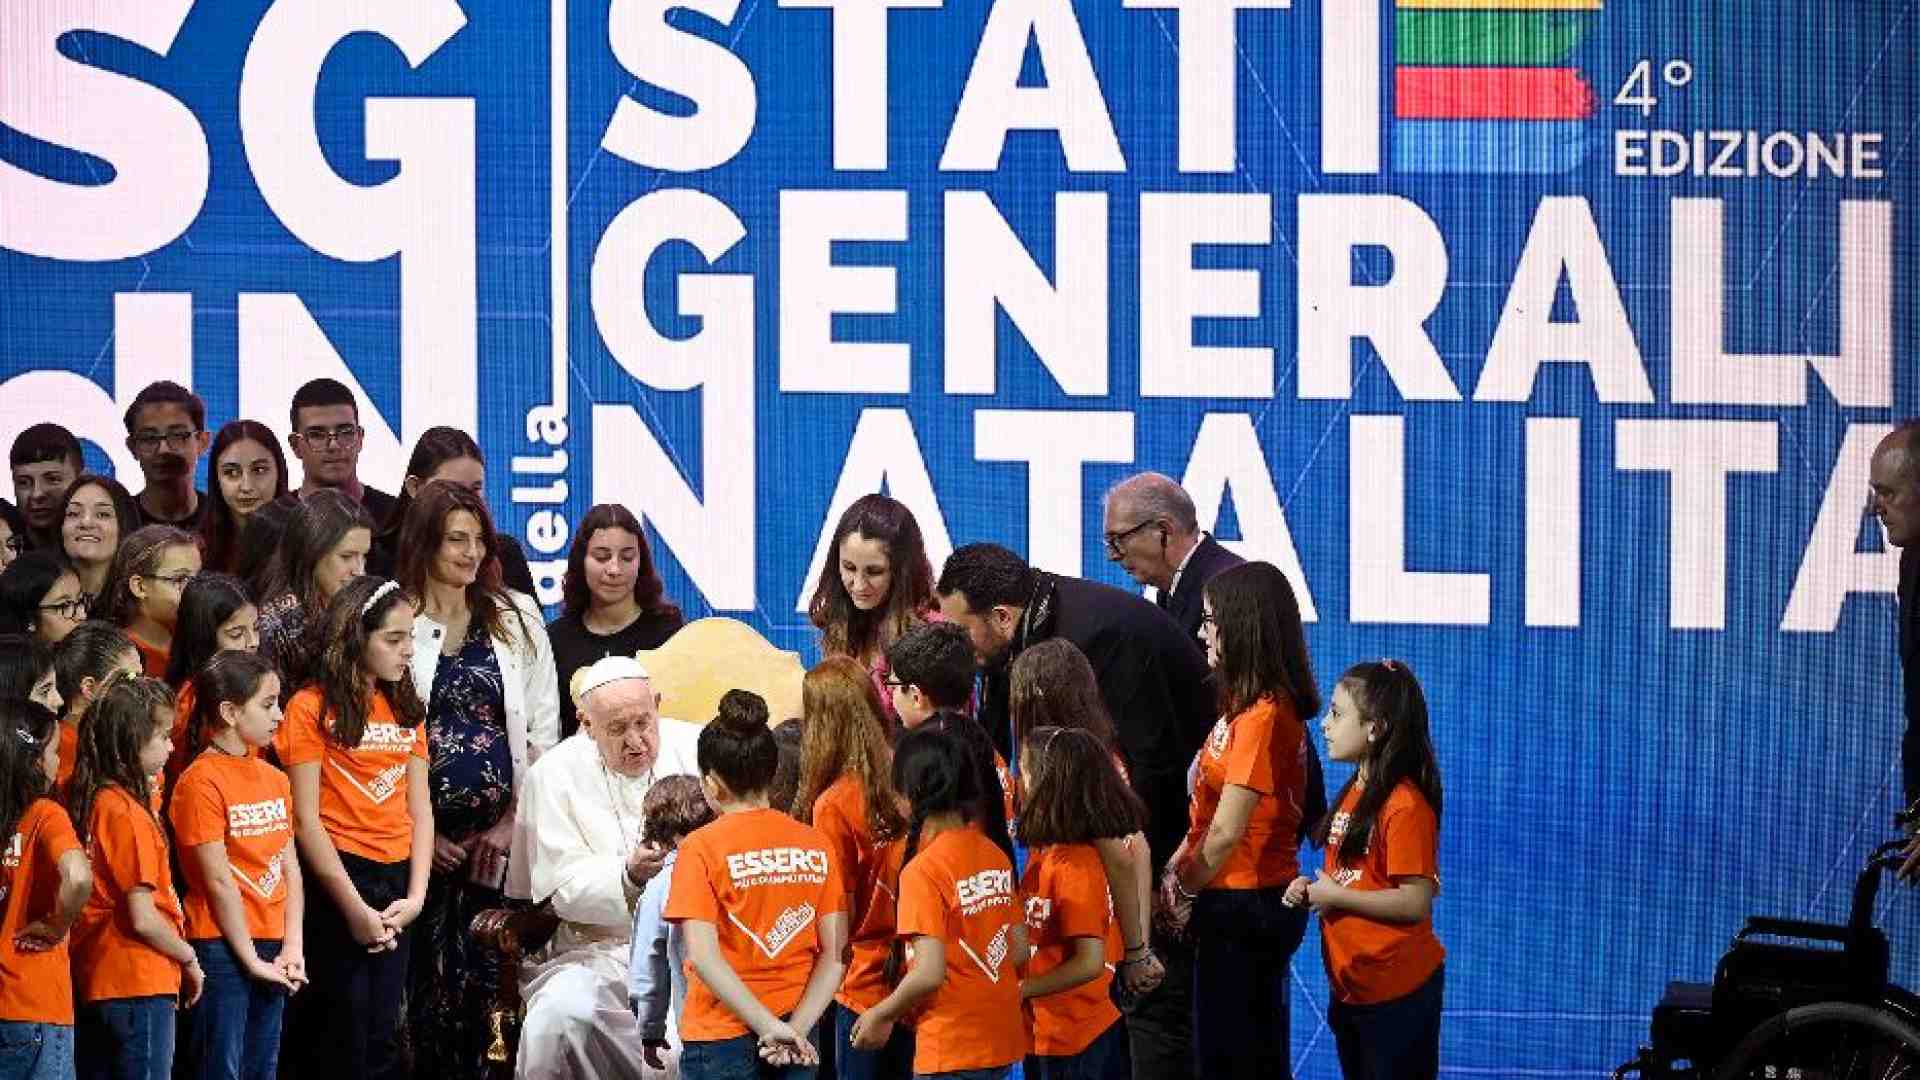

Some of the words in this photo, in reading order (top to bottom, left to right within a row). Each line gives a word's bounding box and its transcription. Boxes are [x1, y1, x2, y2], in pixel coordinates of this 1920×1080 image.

[601, 0, 1379, 173] STATI
[1615, 130, 1883, 178] EDIZIONE
[591, 188, 1893, 408] GENERALI
[511, 404, 569, 606] della
[726, 848, 828, 880] ESSERCI
